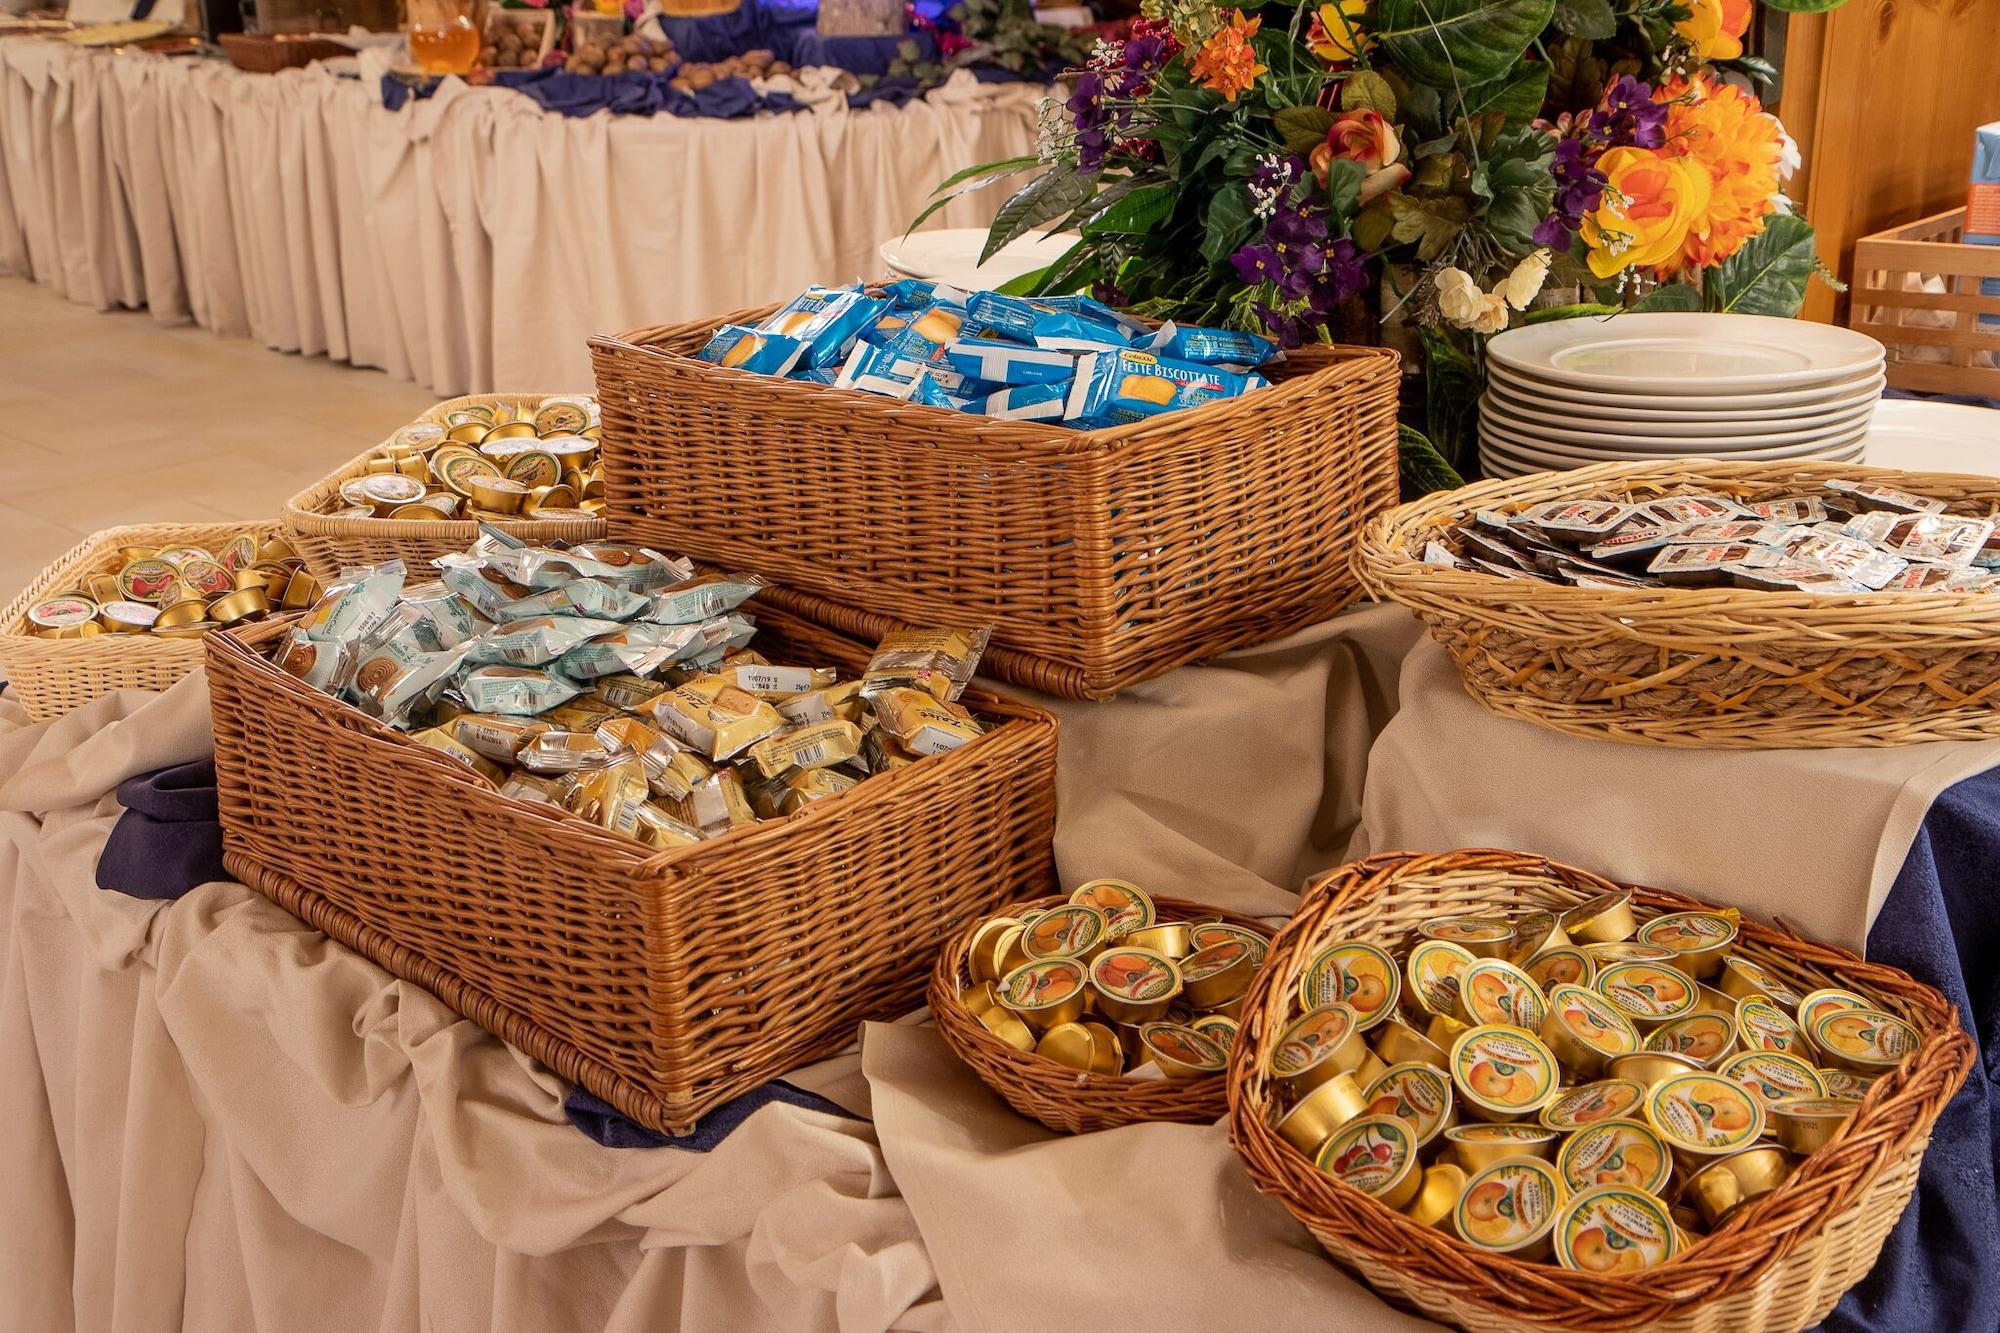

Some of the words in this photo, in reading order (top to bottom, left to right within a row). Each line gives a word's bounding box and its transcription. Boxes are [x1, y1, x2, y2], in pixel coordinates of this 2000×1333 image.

[1123, 352, 1154, 363] Colussi
[1122, 360, 1152, 376] FETTE
[1154, 364, 1220, 386] BISCOTTATE
